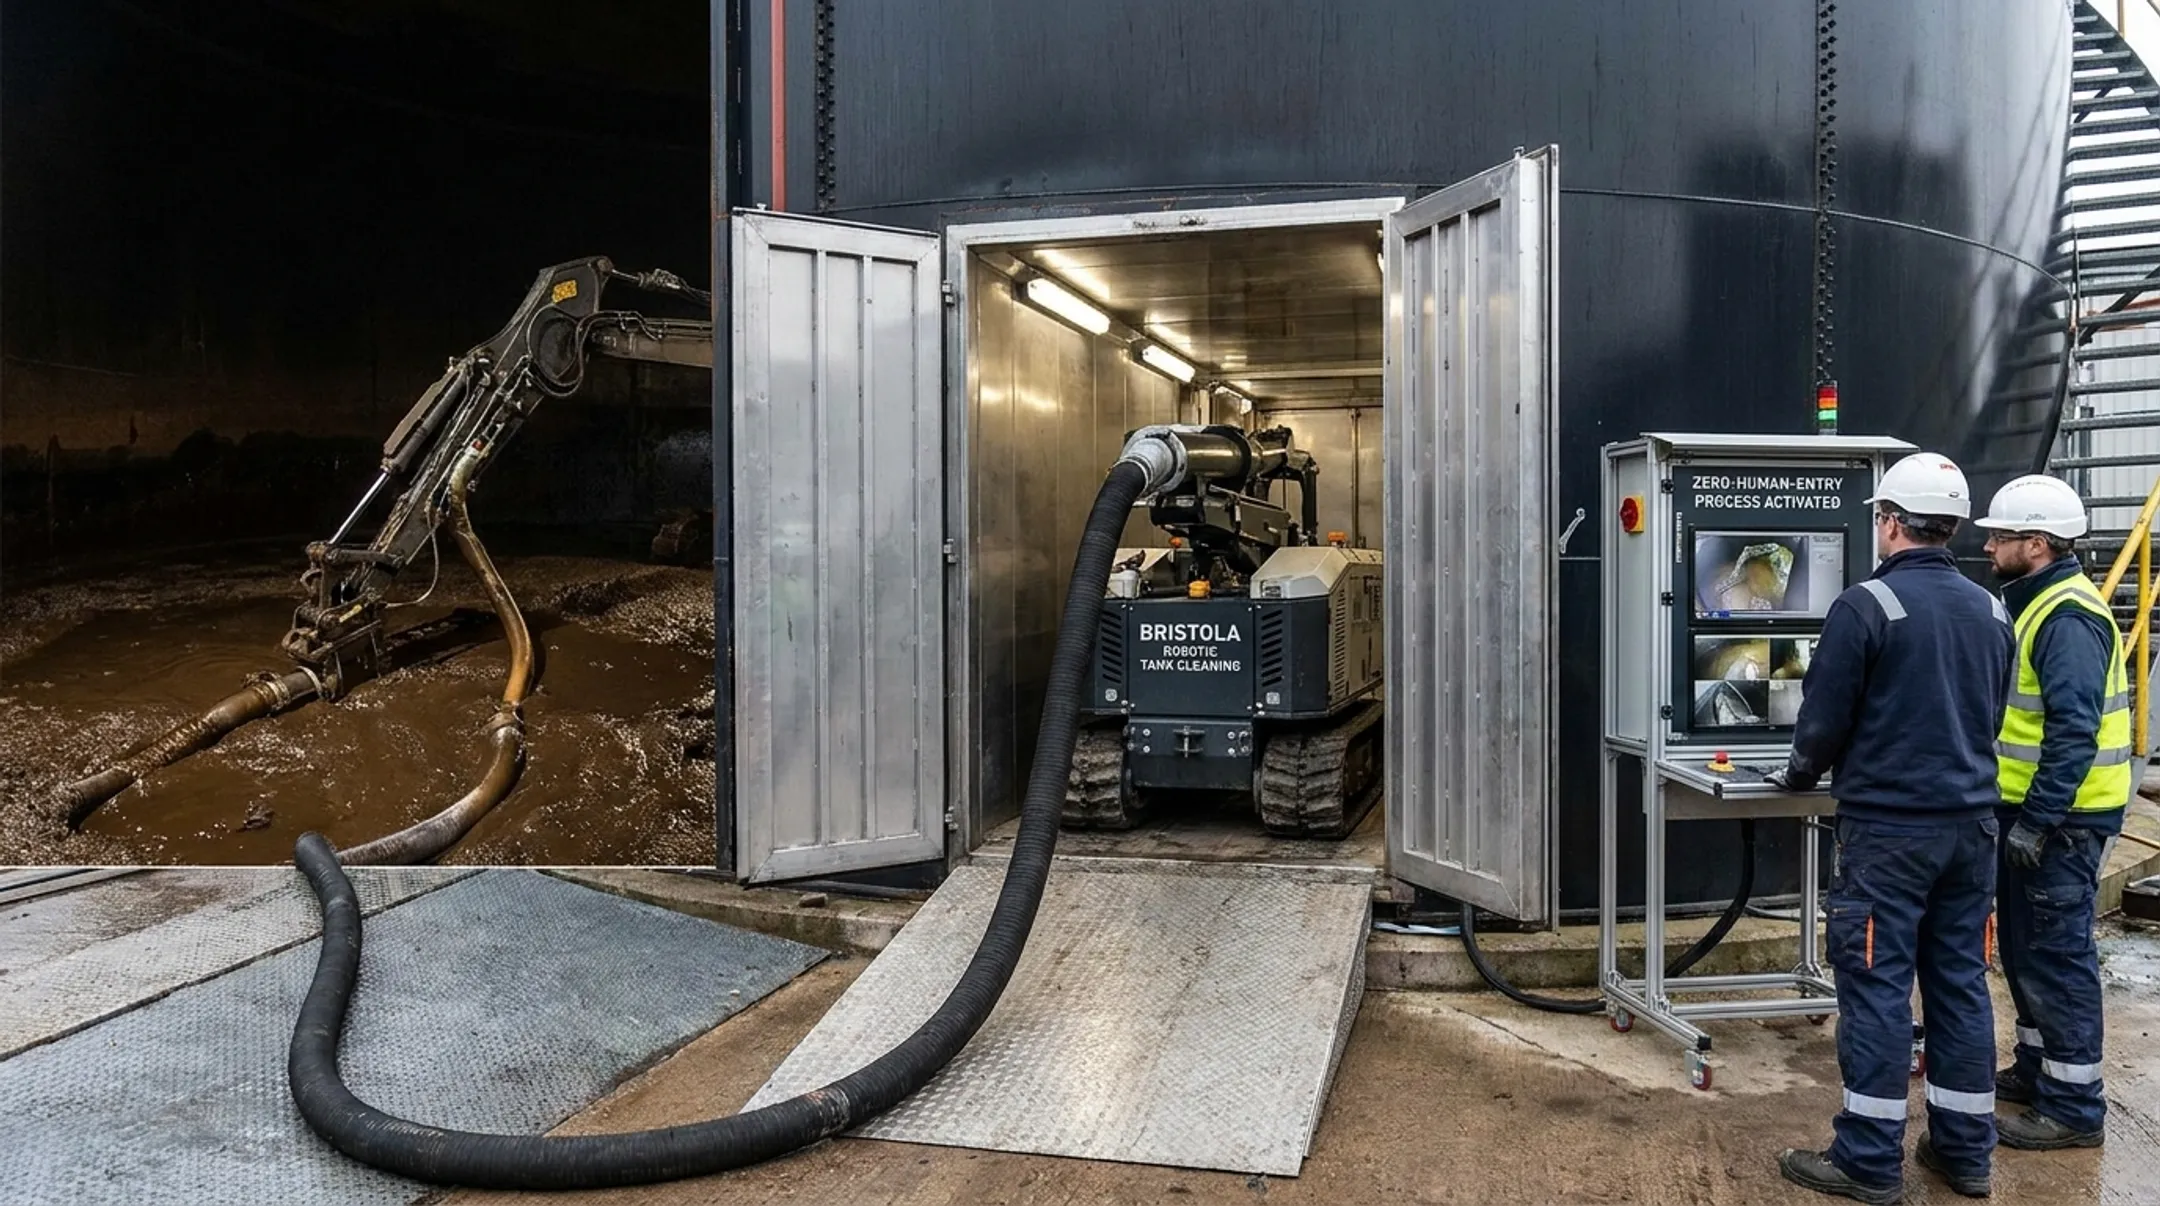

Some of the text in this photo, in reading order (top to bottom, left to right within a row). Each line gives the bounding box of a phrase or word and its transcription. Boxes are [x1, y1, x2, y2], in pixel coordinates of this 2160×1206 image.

[1694, 494, 1842, 511] PROCESS ACTIVATED
[1139, 623, 1242, 642] BRISTOLA
[1163, 645, 1218, 658] ROBOTIC
[1176, 659, 1241, 672] CLEANING
